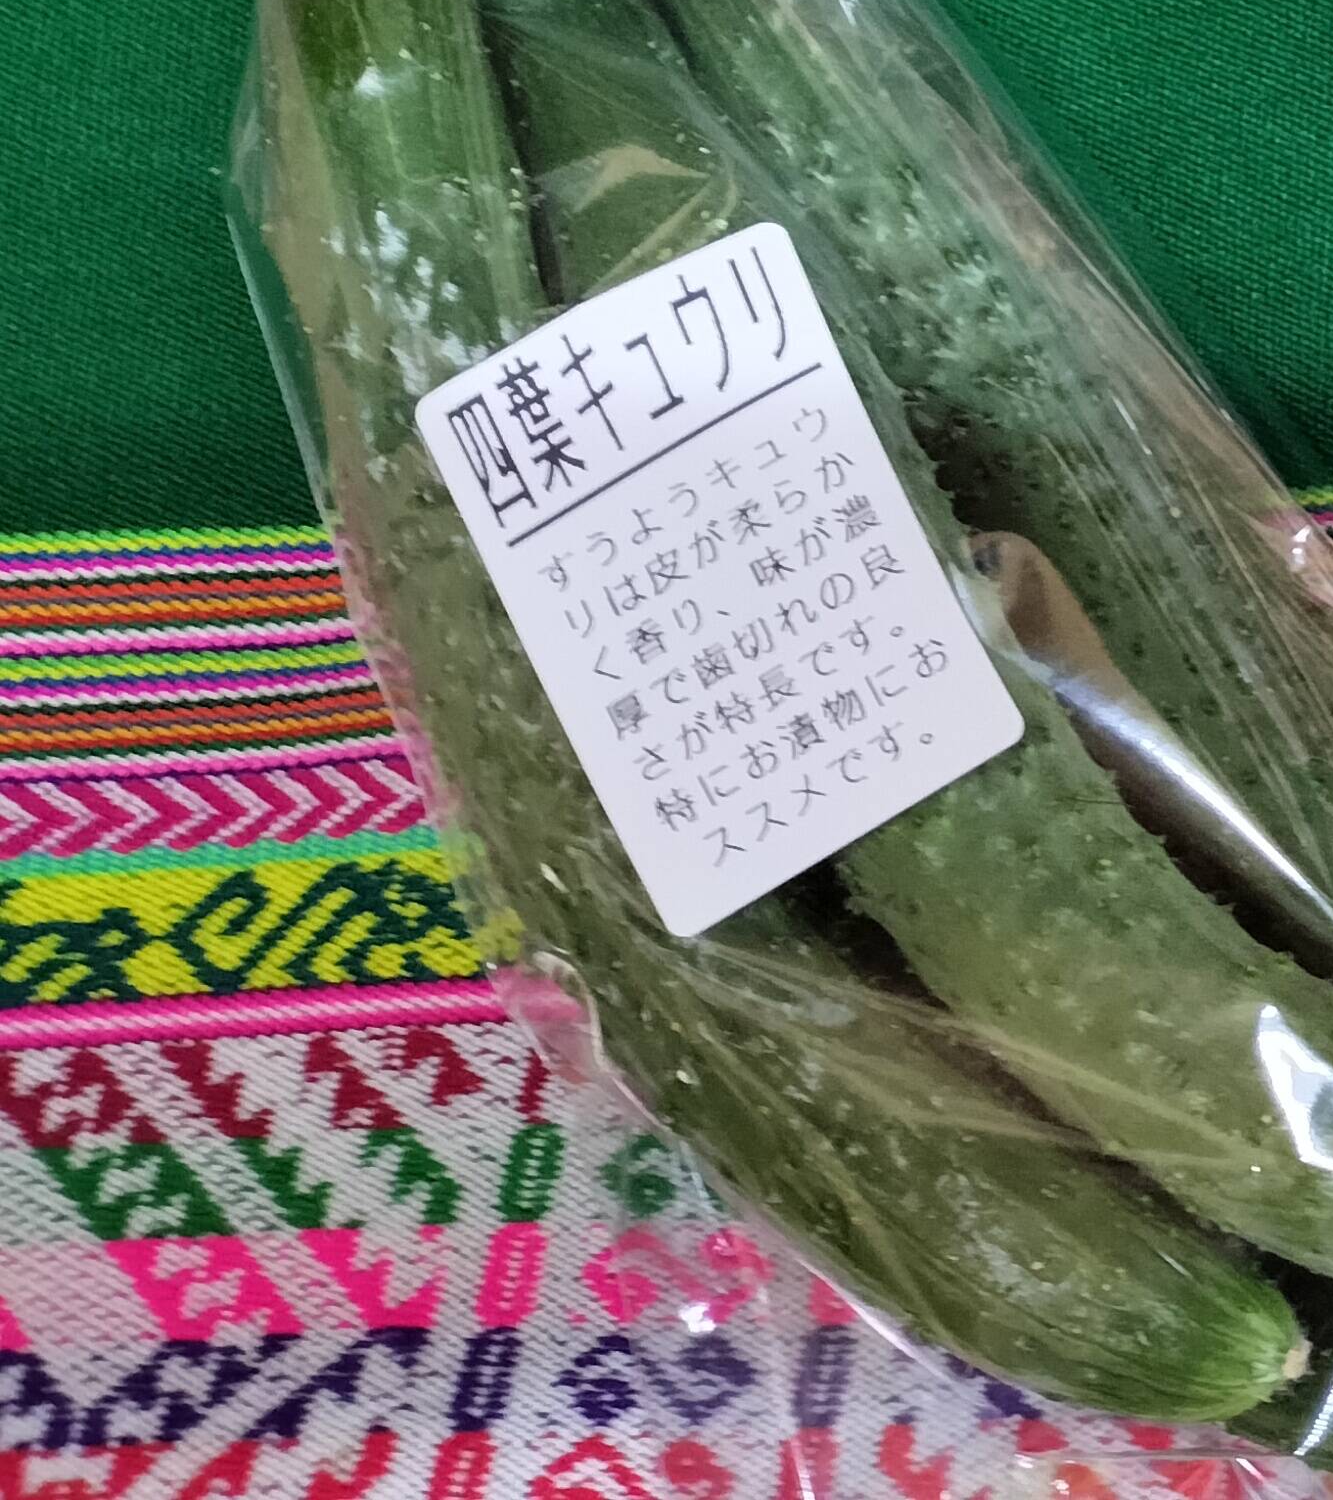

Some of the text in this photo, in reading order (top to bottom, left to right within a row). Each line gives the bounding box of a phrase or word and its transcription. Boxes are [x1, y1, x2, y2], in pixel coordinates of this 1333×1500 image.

[447, 247, 788, 527] 四葉キュウリ
[539, 408, 829, 591] すうようキュウ
[606, 544, 905, 739] 厚で歯切れの良
[636, 616, 904, 781] さが特長です。
[655, 641, 948, 830] 特にお漬物にお
[704, 729, 935, 866] ススメです。
